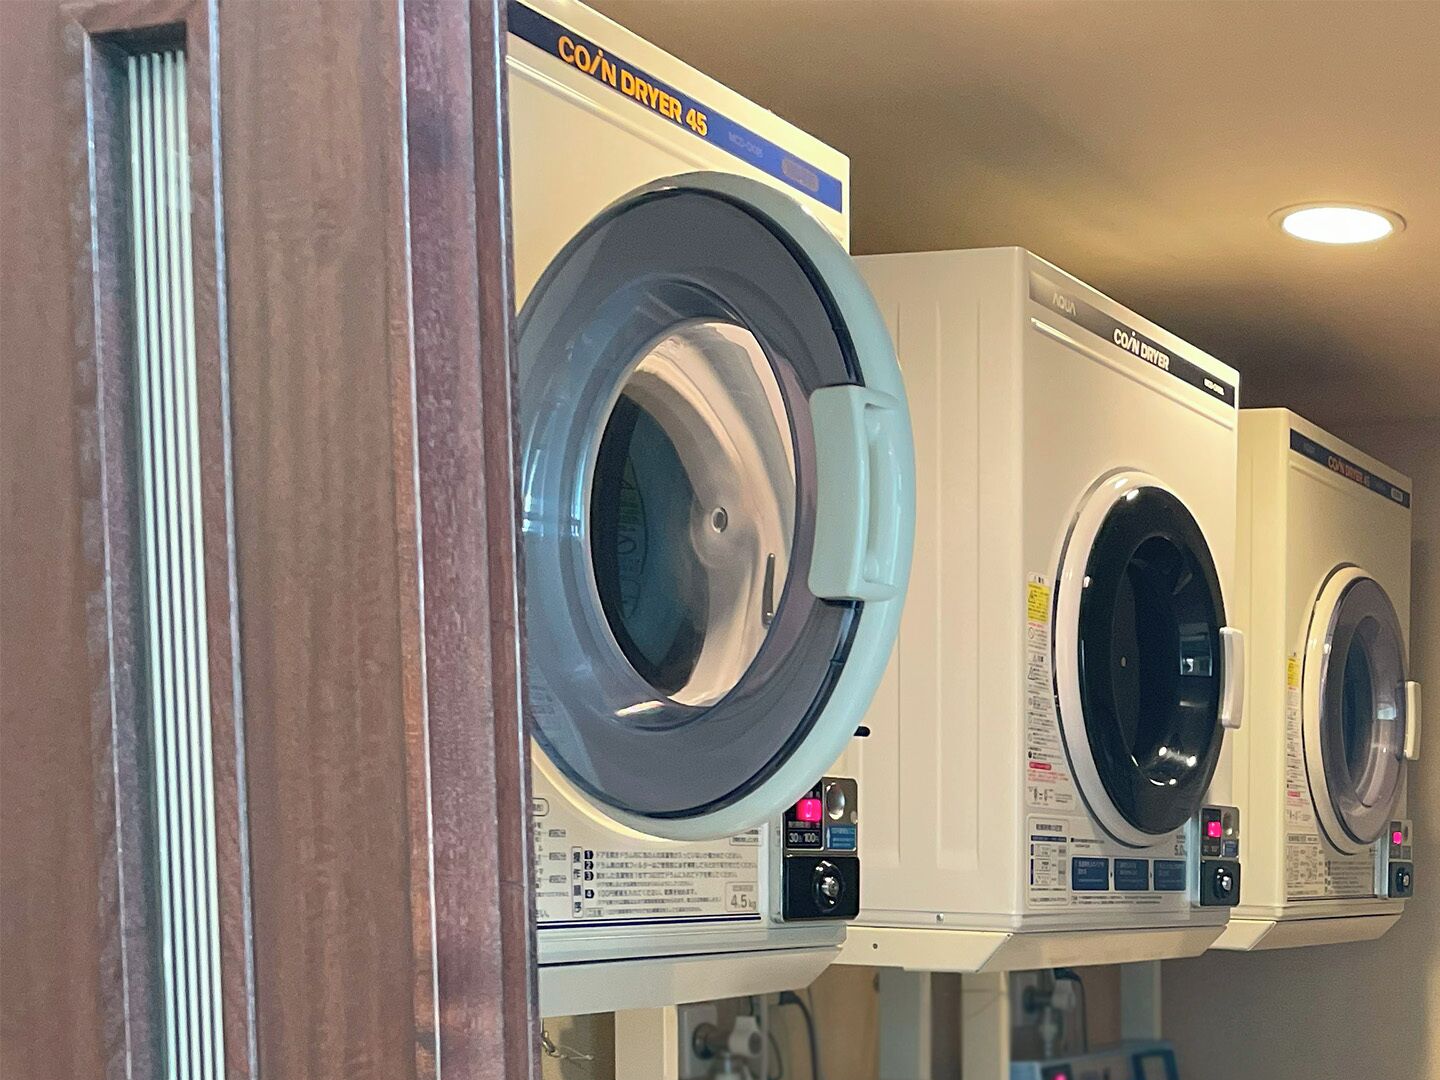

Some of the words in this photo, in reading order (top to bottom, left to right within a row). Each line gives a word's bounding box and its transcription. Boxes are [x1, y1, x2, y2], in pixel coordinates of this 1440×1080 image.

[620, 69, 683, 124] DRYER
[686, 107, 708, 137] 45
[1141, 341, 1171, 371] DRYER
